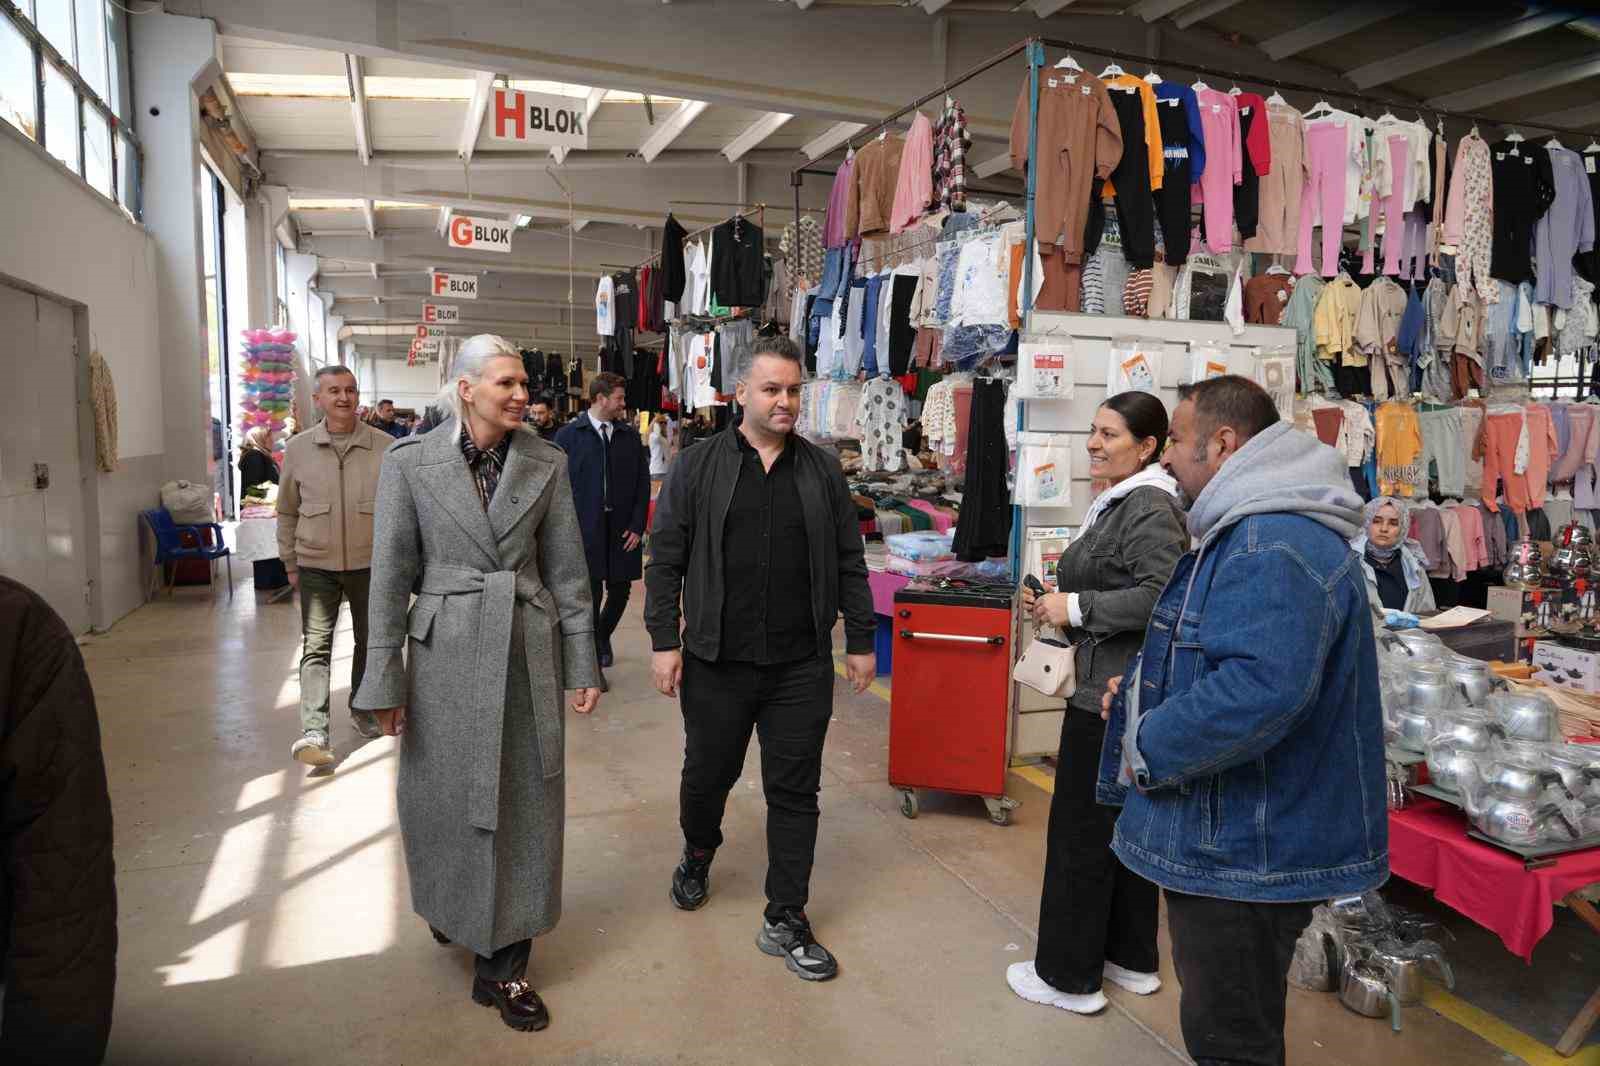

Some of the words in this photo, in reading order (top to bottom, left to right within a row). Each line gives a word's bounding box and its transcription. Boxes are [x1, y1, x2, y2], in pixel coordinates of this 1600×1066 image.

[495, 90, 525, 139] H
[530, 106, 584, 135] BLOK
[451, 216, 473, 246] G
[475, 226, 509, 244] BLOK
[434, 274, 448, 294] F
[450, 280, 476, 293] BLOK
[425, 305, 436, 321] E
[437, 310, 457, 320] BLOK
[417, 325, 428, 338] D
